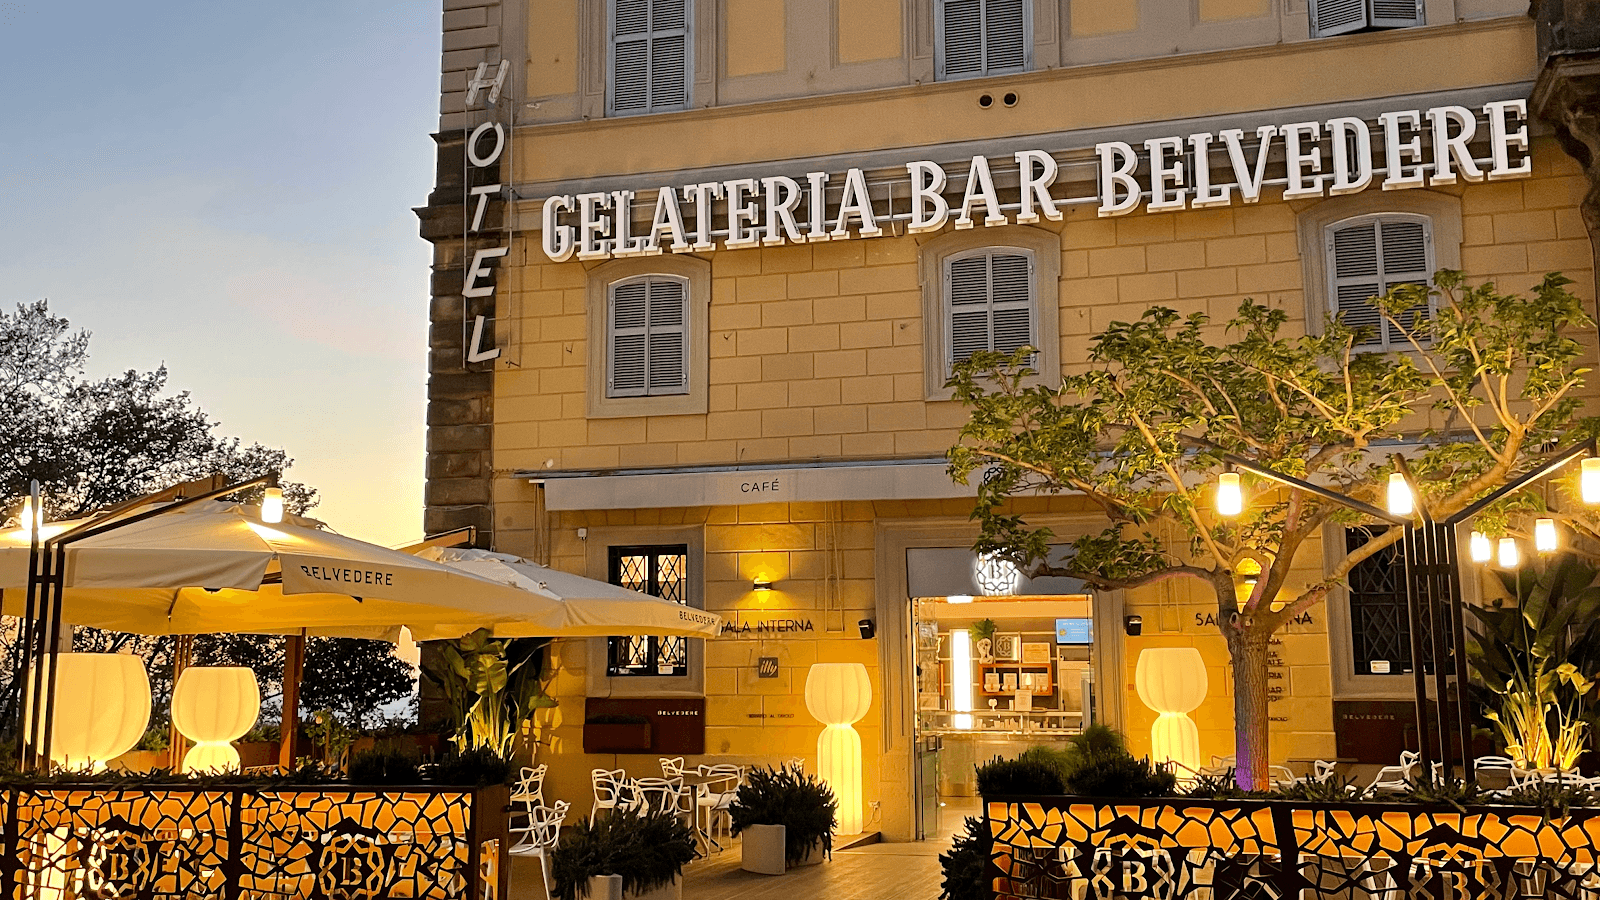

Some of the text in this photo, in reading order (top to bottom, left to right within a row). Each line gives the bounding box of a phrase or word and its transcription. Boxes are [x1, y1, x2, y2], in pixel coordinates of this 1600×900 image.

[542, 98, 1532, 262] GELATERIA BAR BELVEDERE
[462, 58, 509, 363] HOTEL
[740, 478, 780, 493] CAFÉ
[300, 565, 393, 586] BELVEDERE
[679, 610, 715, 626] BELVEDERE
[721, 619, 814, 633] ALA INTERNA
[760, 659, 777, 676] illy
[1118, 861, 1147, 893] B
